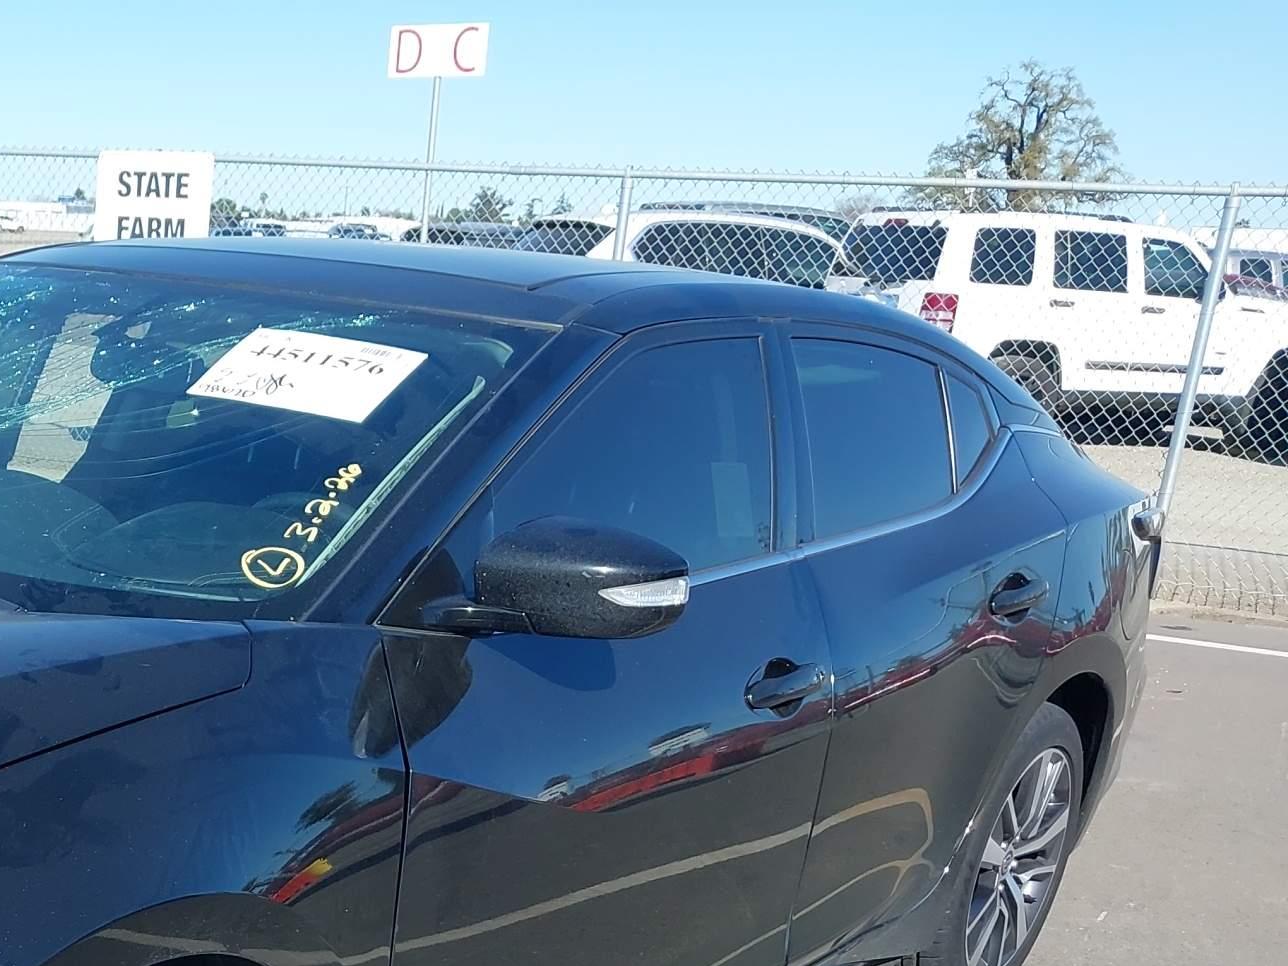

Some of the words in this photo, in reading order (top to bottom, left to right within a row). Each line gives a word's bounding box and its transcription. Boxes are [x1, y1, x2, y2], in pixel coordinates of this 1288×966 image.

[396, 29, 422, 73] D
[453, 26, 479, 73] C
[117, 170, 190, 199] STATE
[117, 216, 186, 239] FARM
[250, 345, 385, 375] 44511576
